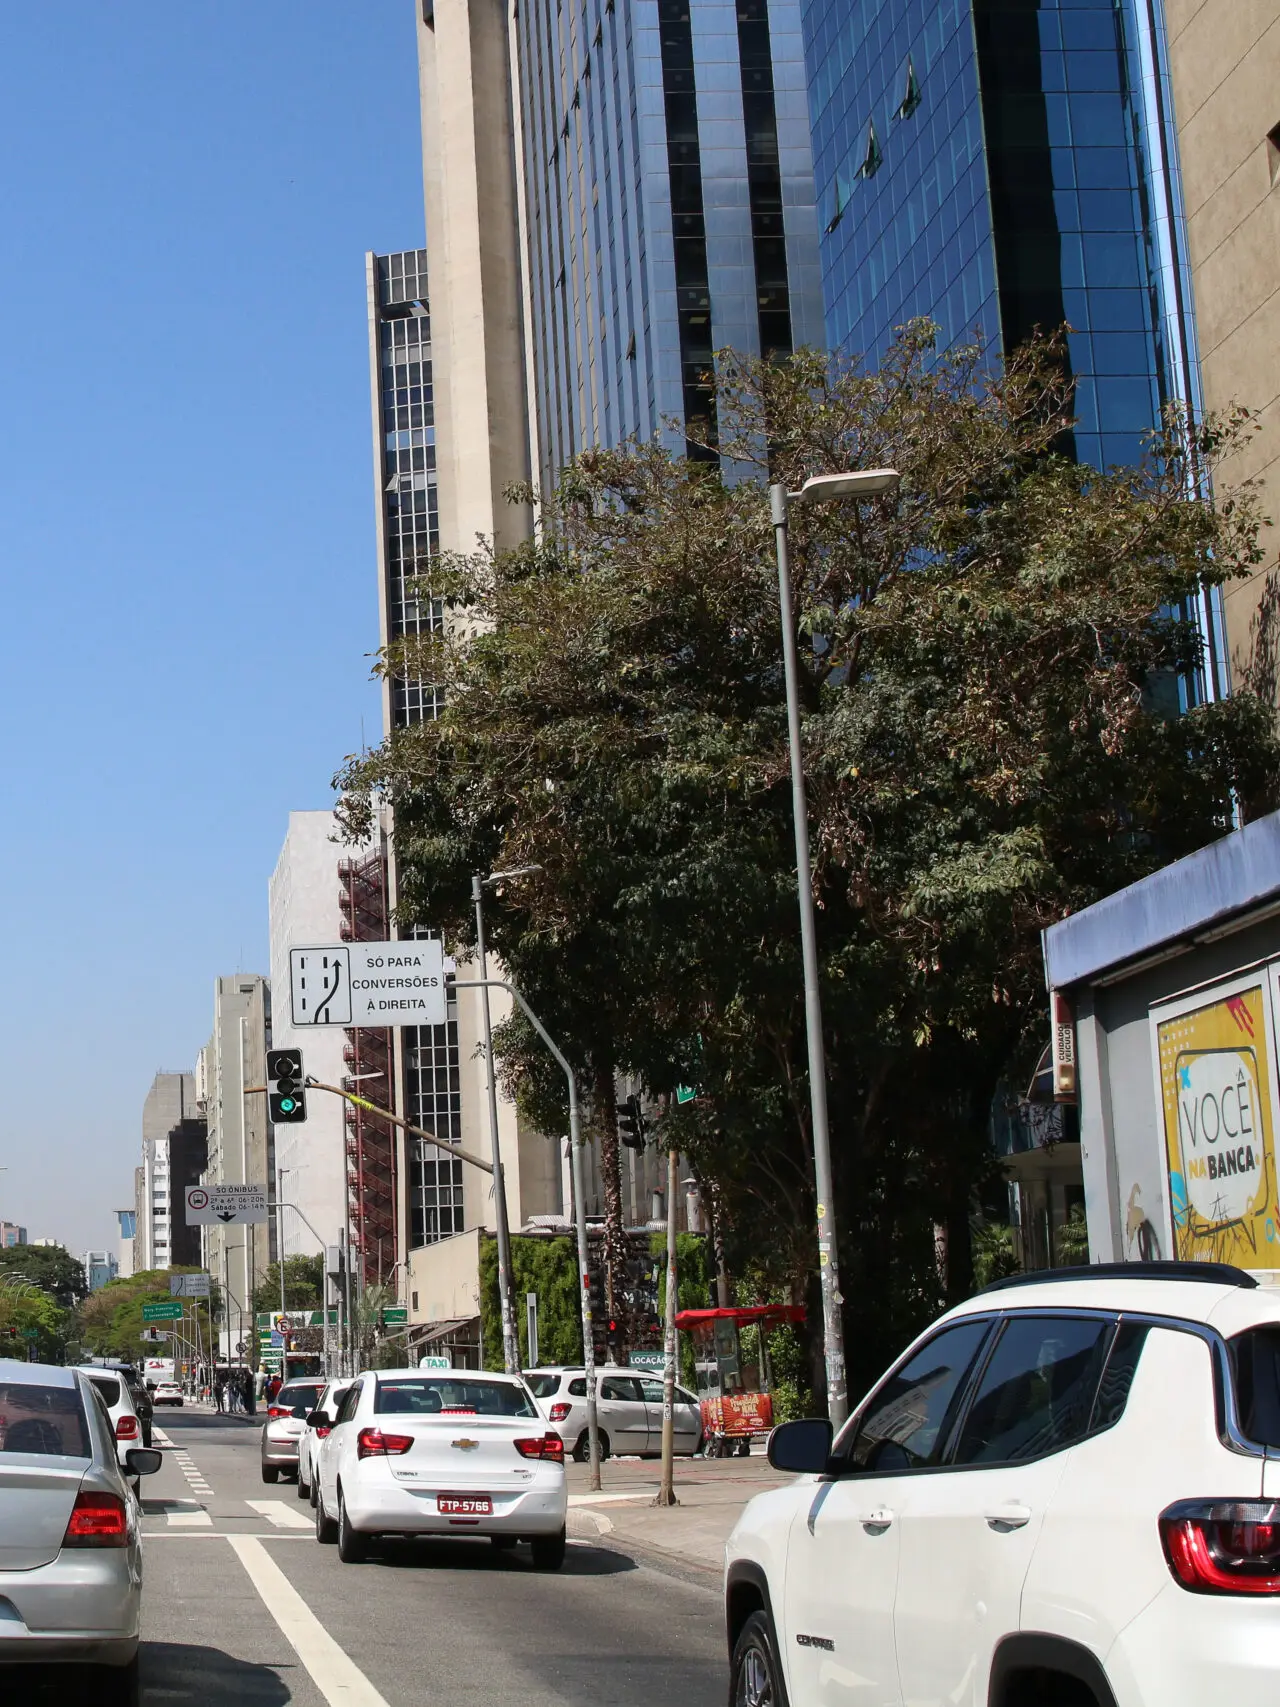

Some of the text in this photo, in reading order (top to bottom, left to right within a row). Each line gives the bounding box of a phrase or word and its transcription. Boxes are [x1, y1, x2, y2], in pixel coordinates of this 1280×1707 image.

[366, 955, 421, 968] SÓ PARA
[352, 975, 438, 990] CONVERSÕES
[367, 999, 426, 1010] À DIREITA
[1182, 1066, 1252, 1148] VOCÊ
[1188, 1155, 1207, 1180] NA
[424, 1358, 448, 1368] TAXI
